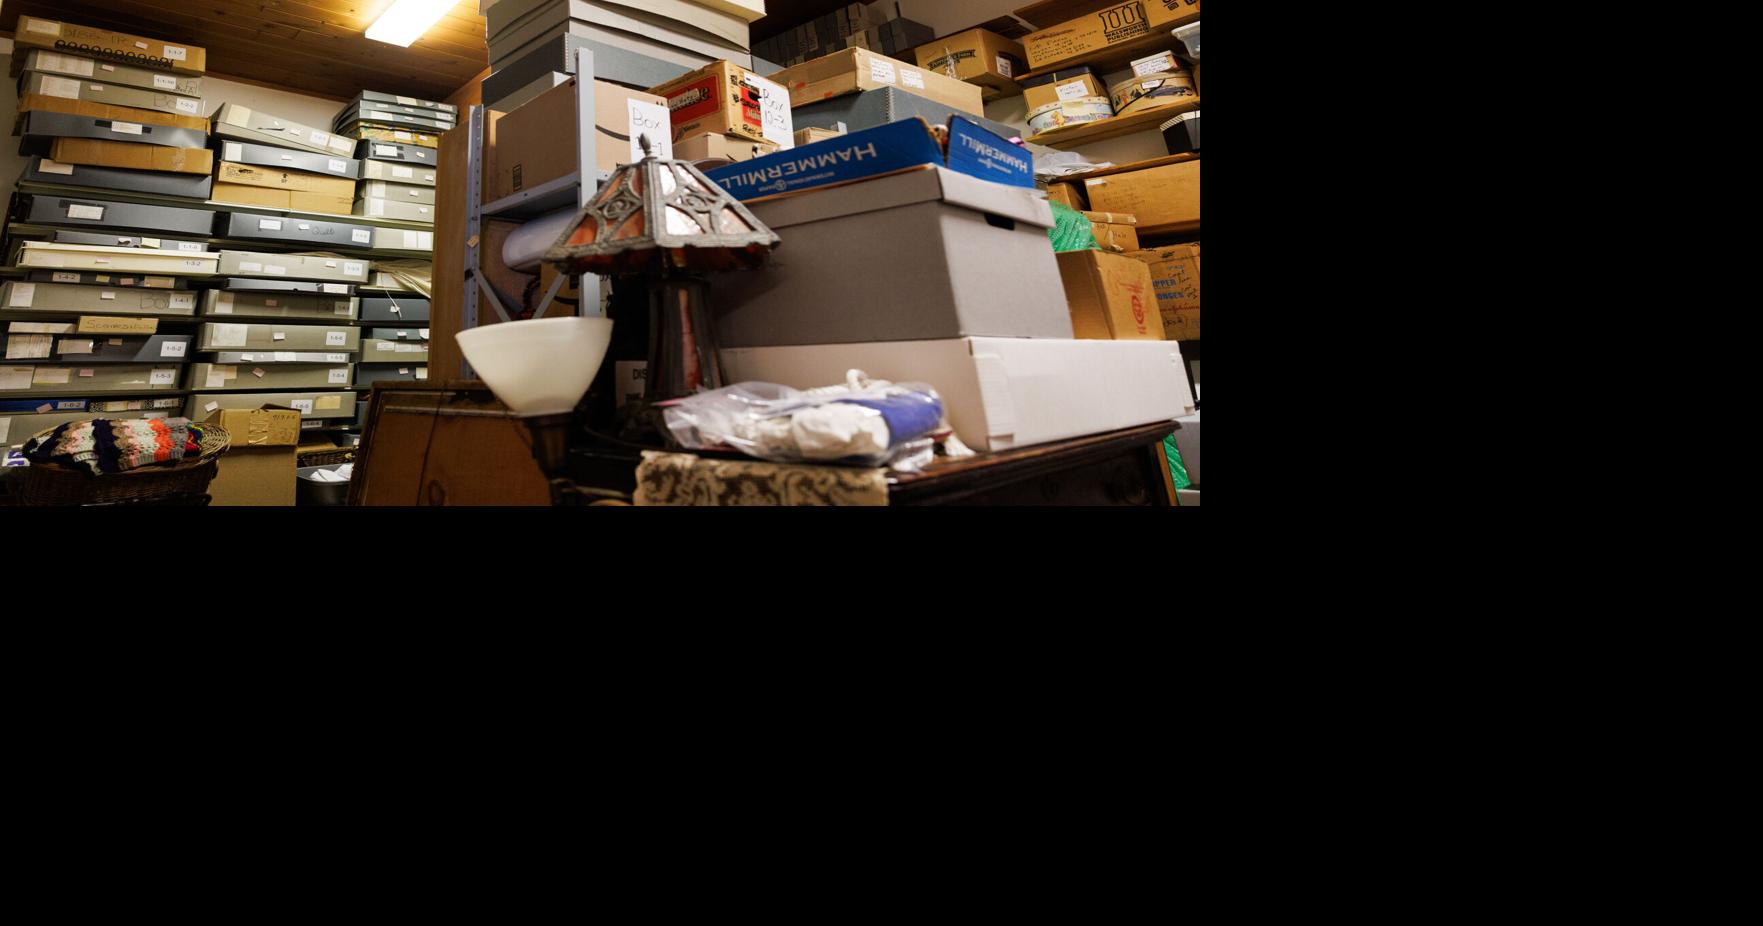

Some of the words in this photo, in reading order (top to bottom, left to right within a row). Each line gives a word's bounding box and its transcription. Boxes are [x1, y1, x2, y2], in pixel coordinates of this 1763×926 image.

[1104, 21, 1148, 38] WALSWORTH
[1106, 27, 1150, 41] PUBLISHING
[632, 106, 660, 129] Box
[635, 135, 664, 157] 1-1
[959, 132, 1028, 174] HAMMERMILL
[719, 142, 878, 190] HAMMERMILL
